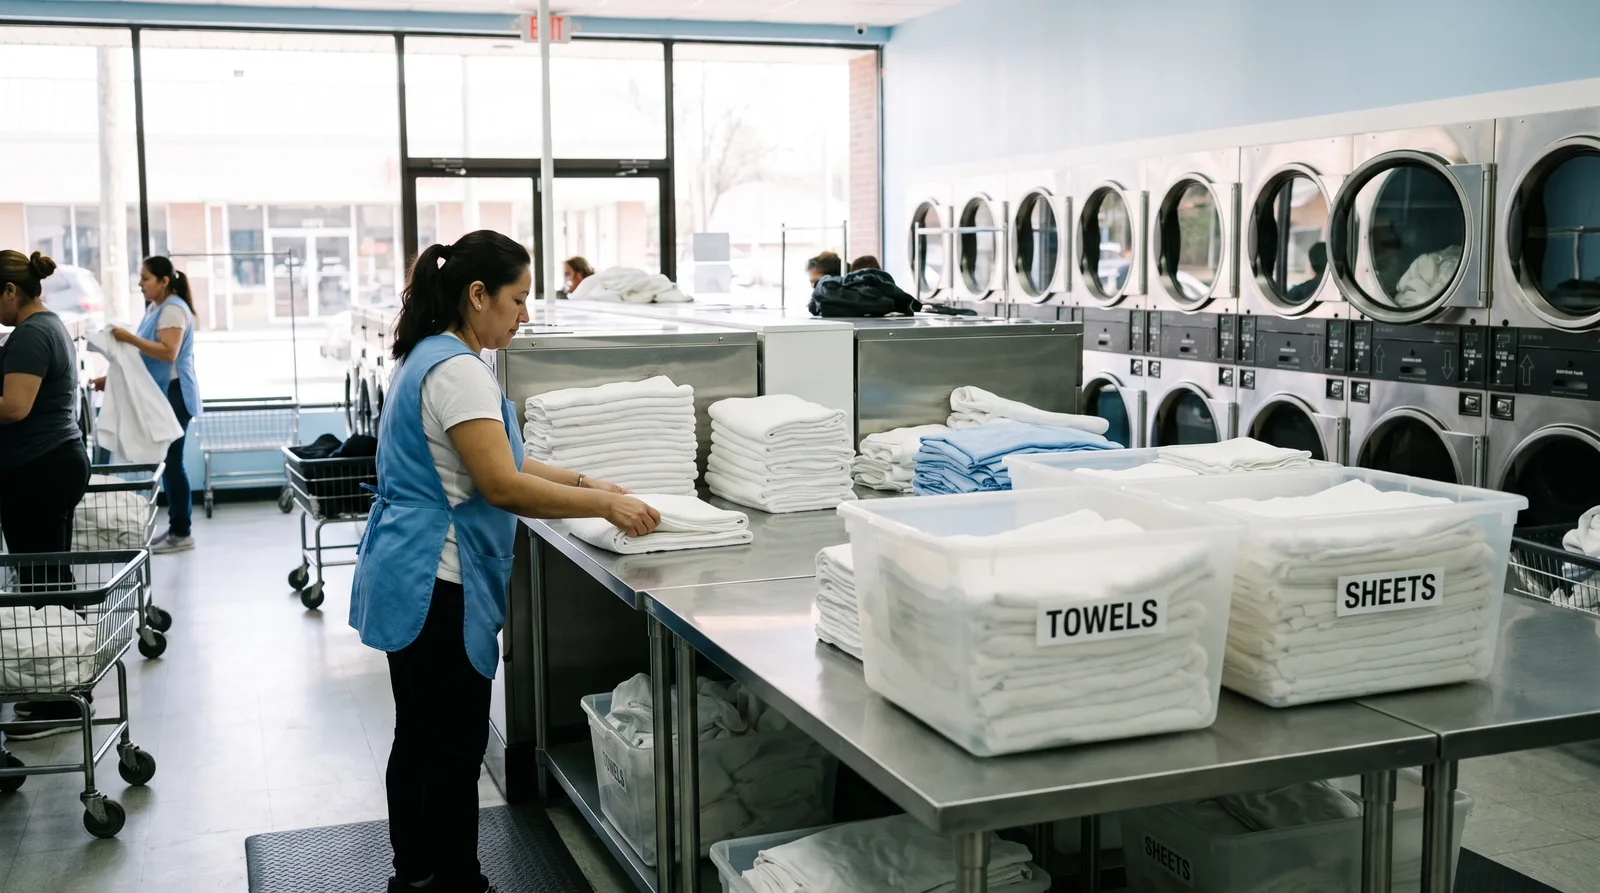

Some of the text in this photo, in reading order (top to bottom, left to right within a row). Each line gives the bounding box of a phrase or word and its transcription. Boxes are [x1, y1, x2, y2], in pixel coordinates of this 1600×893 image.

[530, 16, 563, 40] EIT
[1345, 573, 1436, 609] SHEETS
[1046, 599, 1158, 638] TOWELS
[1145, 835, 1190, 881] SHEETS
